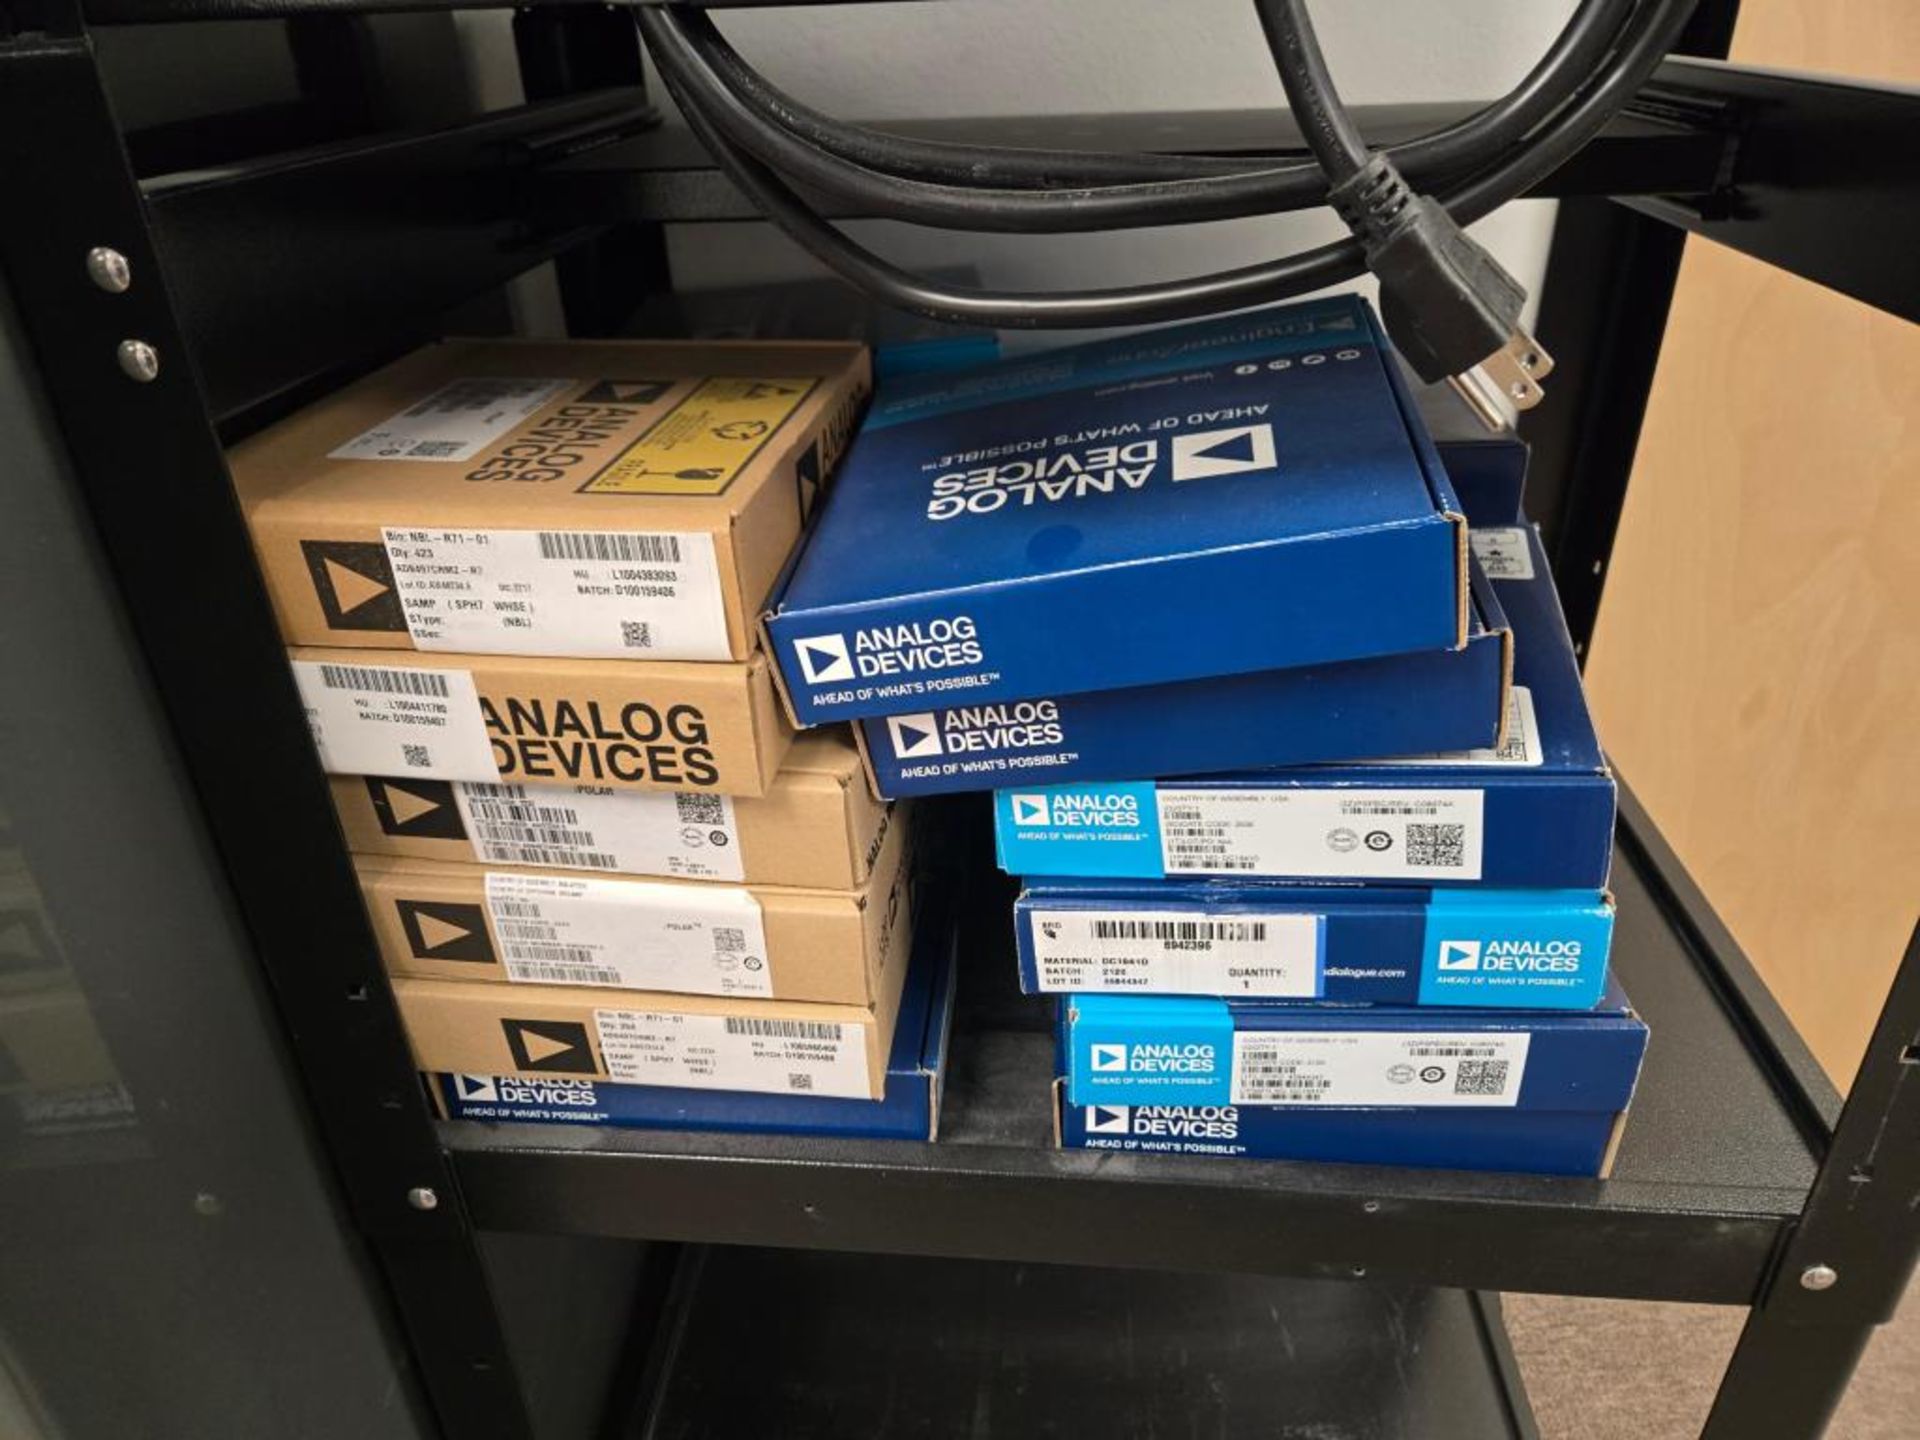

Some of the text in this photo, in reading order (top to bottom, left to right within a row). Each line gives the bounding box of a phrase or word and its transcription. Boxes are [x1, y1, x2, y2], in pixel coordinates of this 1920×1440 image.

[1188, 403, 1269, 424] AHEAD
[1150, 416, 1178, 431] OF
[1053, 422, 1141, 447] WHAT'S
[465, 405, 600, 482] DEVICES
[514, 405, 638, 482] ANALOG
[932, 440, 1159, 497] DEVICES
[927, 463, 1157, 521] ANALOG
[405, 600, 436, 609] SAMP
[855, 615, 976, 653] ANALOG
[857, 641, 983, 677] DEVICES
[813, 691, 854, 706] AHEAD
[857, 688, 874, 700] OF
[878, 681, 923, 698] WHAT'S
[479, 697, 708, 745] ANALOG
[945, 700, 1058, 731] ANALOG
[946, 723, 1064, 754] DEVICES
[901, 765, 941, 779] AHEAD
[943, 762, 958, 774] OF
[961, 758, 1006, 772] WHAT'S
[1053, 794, 1138, 811] ANALOG
[1053, 811, 1140, 826] DEVICES
[1017, 832, 1046, 840] AHEAD
[1048, 832, 1060, 840] OF
[1063, 832, 1097, 841] WHAT'S
[1485, 940, 1582, 956] ANALOG
[1044, 956, 1096, 965] MATERIAL:
[1482, 956, 1579, 972] DEVICES
[1228, 968, 1287, 978] QUANTITY:
[1323, 967, 1406, 979] dialogue.com
[1436, 976, 1470, 985] AHEAD
[1472, 977, 1486, 985] OF
[1488, 977, 1525, 986] WHAT'S
[1243, 980, 1250, 988] 1
[1131, 1044, 1215, 1059] ANALOG
[1131, 1059, 1215, 1072] DEVICES
[1092, 1077, 1121, 1085] AHEAD
[1123, 1077, 1136, 1085] OF
[1138, 1077, 1169, 1085] WHAT'S
[502, 1087, 597, 1106] DEVICES
[462, 1107, 496, 1117] AHEAD
[498, 1109, 510, 1117] OF
[513, 1109, 550, 1119] WHAT'S
[1136, 1106, 1238, 1122] ANALOG
[1134, 1120, 1238, 1139] DEVICES
[1085, 1139, 1122, 1148] AHEAD
[1124, 1140, 1138, 1149] OF
[1141, 1141, 1181, 1152] WHAT'S
